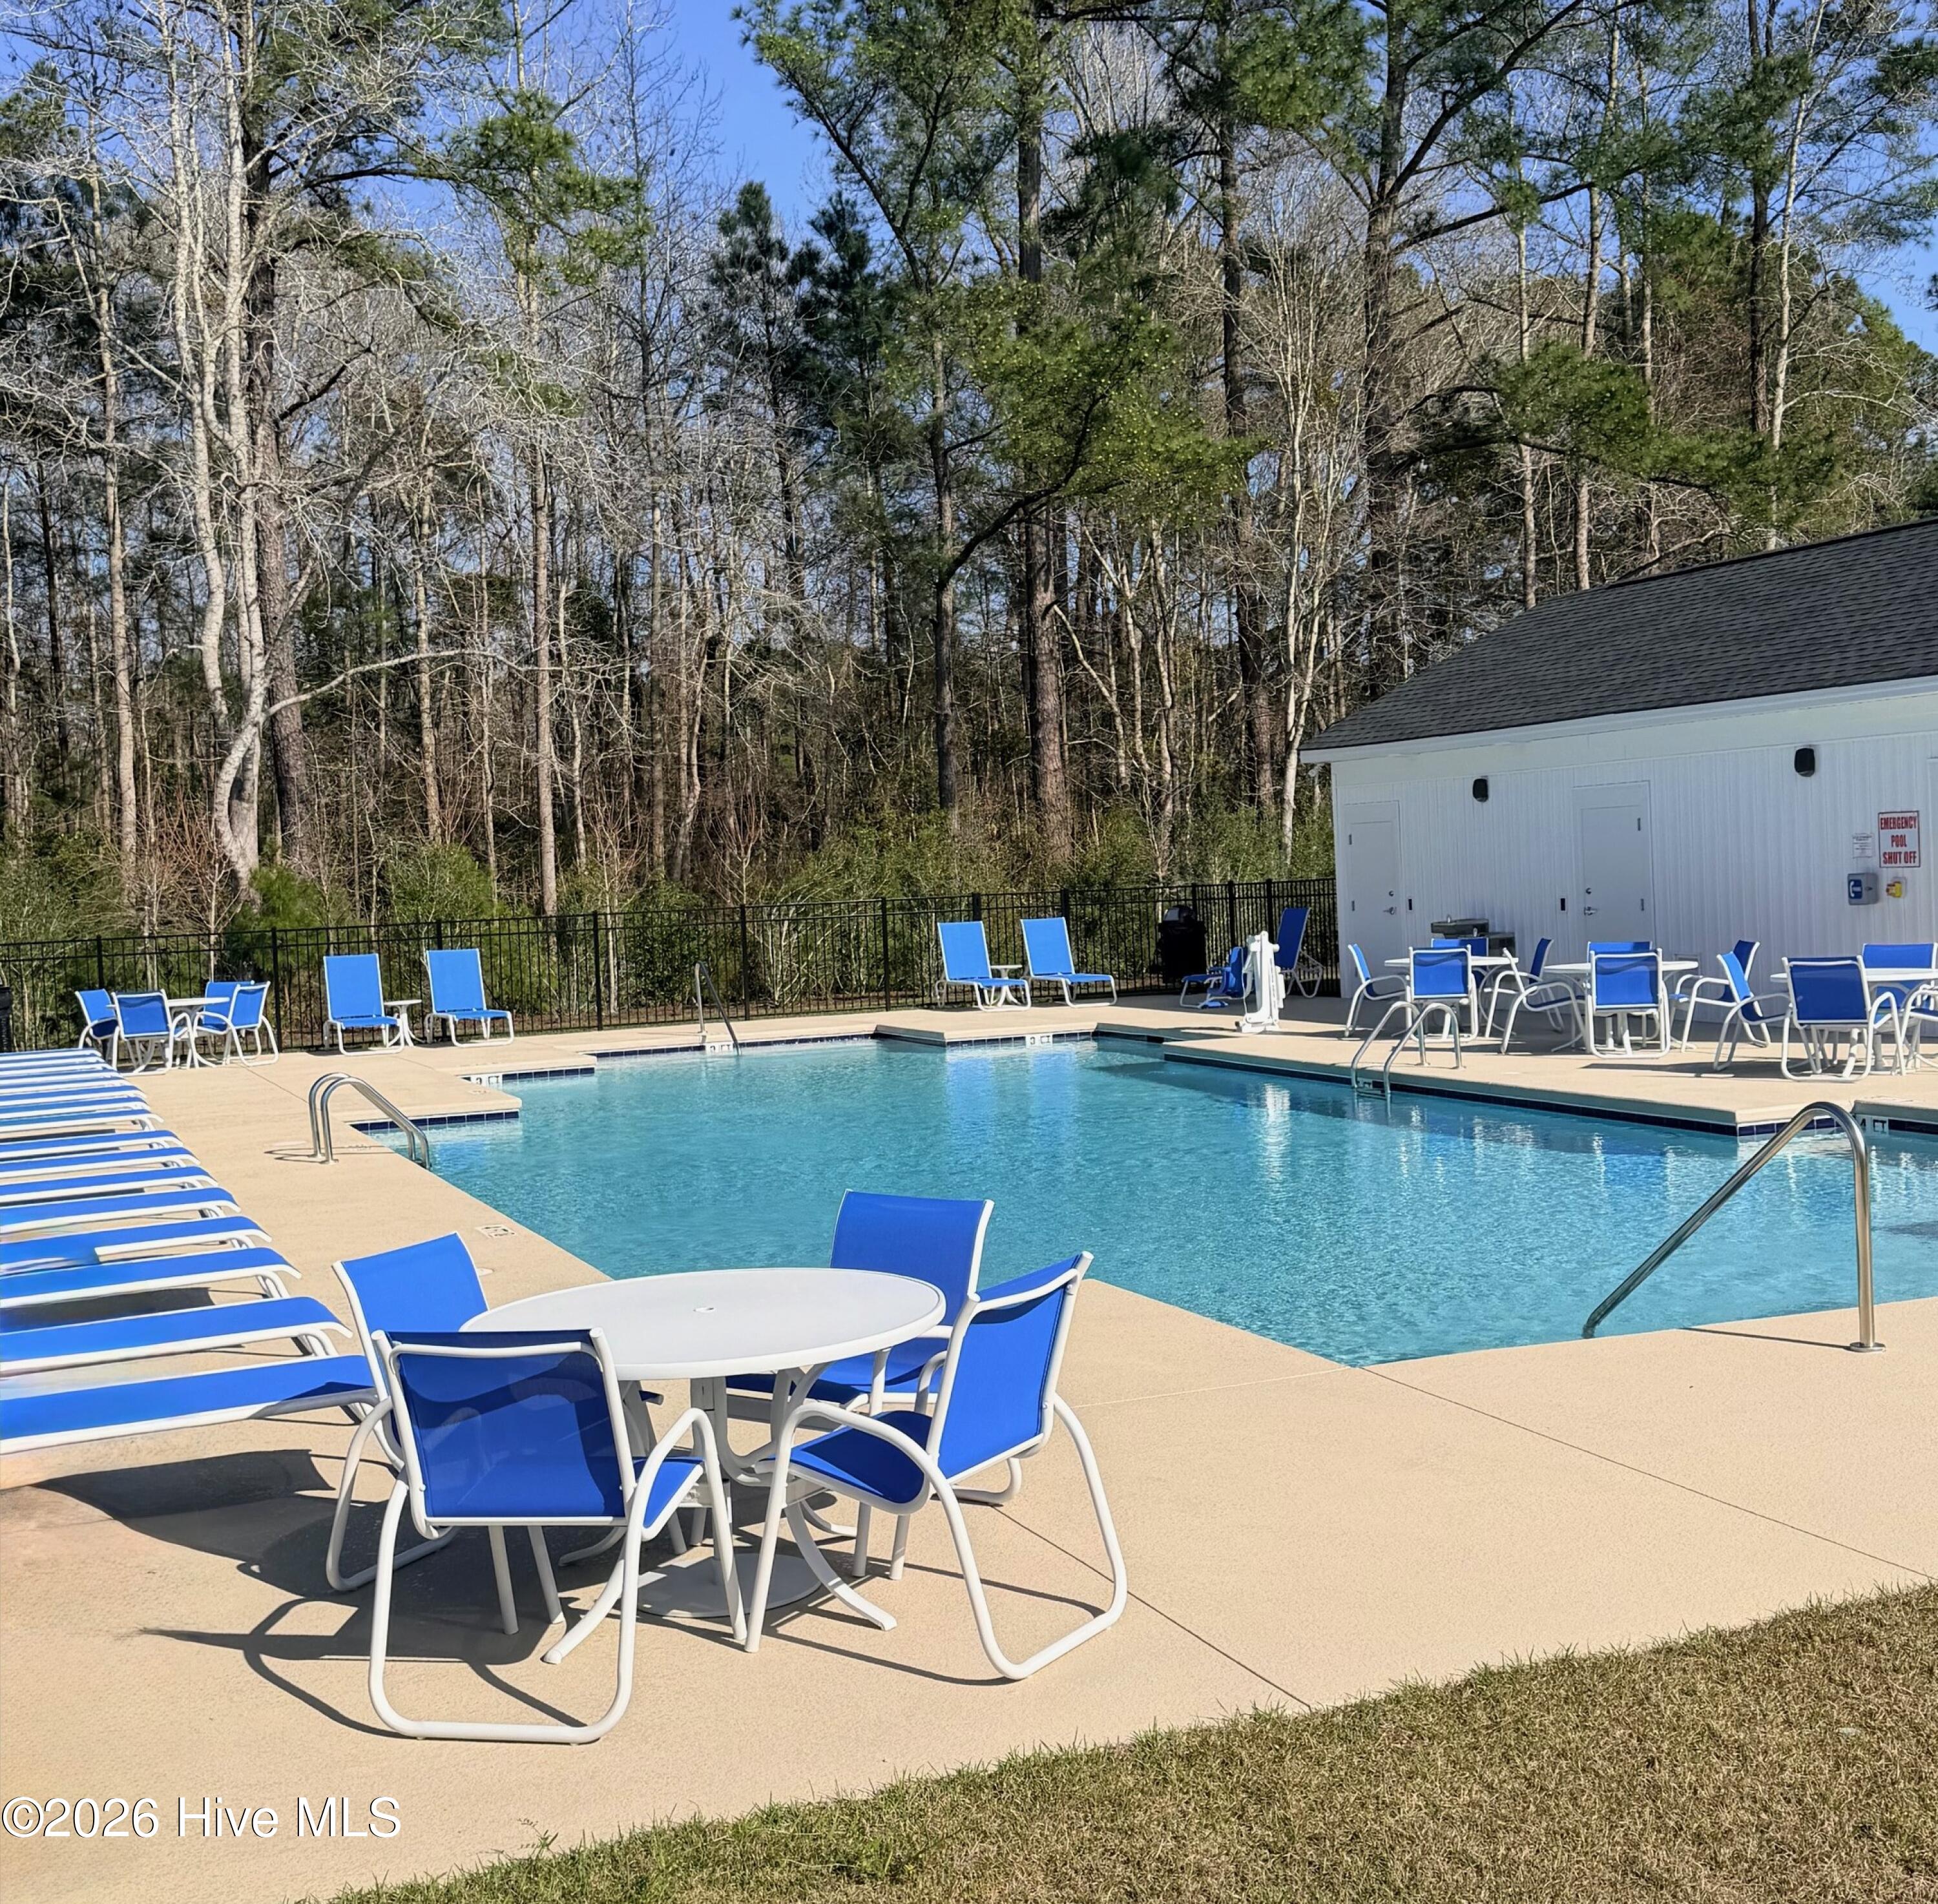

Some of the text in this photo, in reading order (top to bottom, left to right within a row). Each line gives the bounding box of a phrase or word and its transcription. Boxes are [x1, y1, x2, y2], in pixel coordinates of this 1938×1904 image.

[1881, 816, 1917, 830] EMERGENCY
[1891, 834, 1907, 847] POOL
[1883, 851, 1917, 864] SHUT OFF
